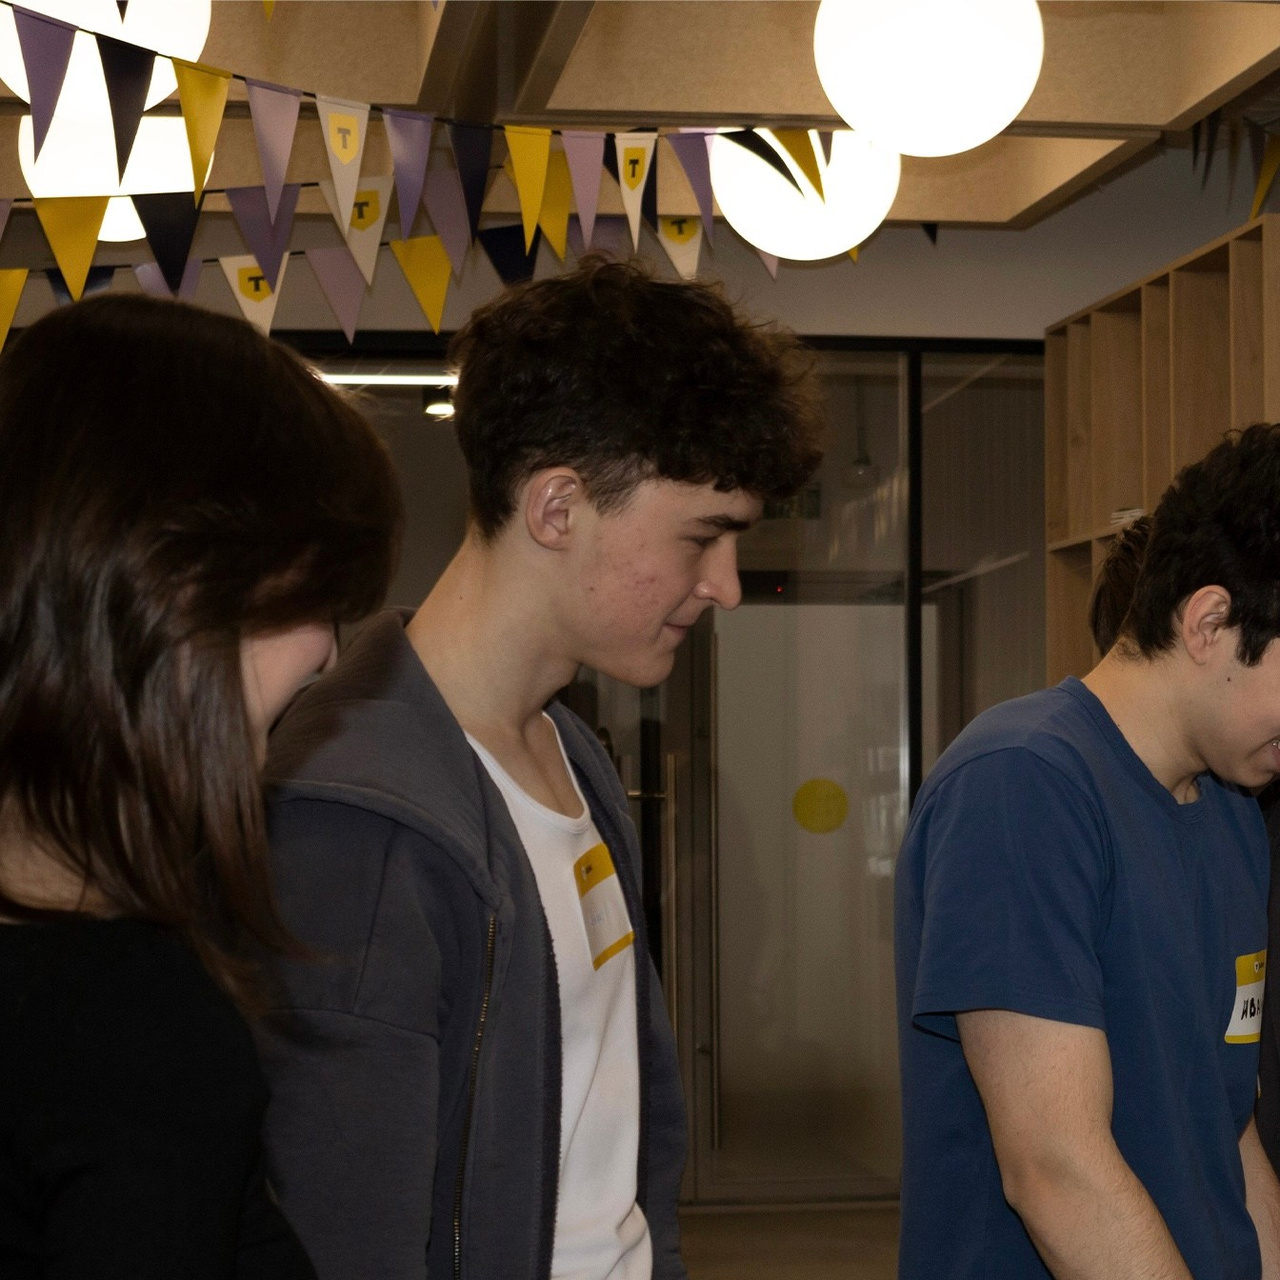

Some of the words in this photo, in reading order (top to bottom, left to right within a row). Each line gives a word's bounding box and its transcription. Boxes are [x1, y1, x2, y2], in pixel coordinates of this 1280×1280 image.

[337, 127, 351, 149] T
[628, 159, 639, 178] T
[353, 201, 369, 219] T
[247, 275, 265, 292] T
